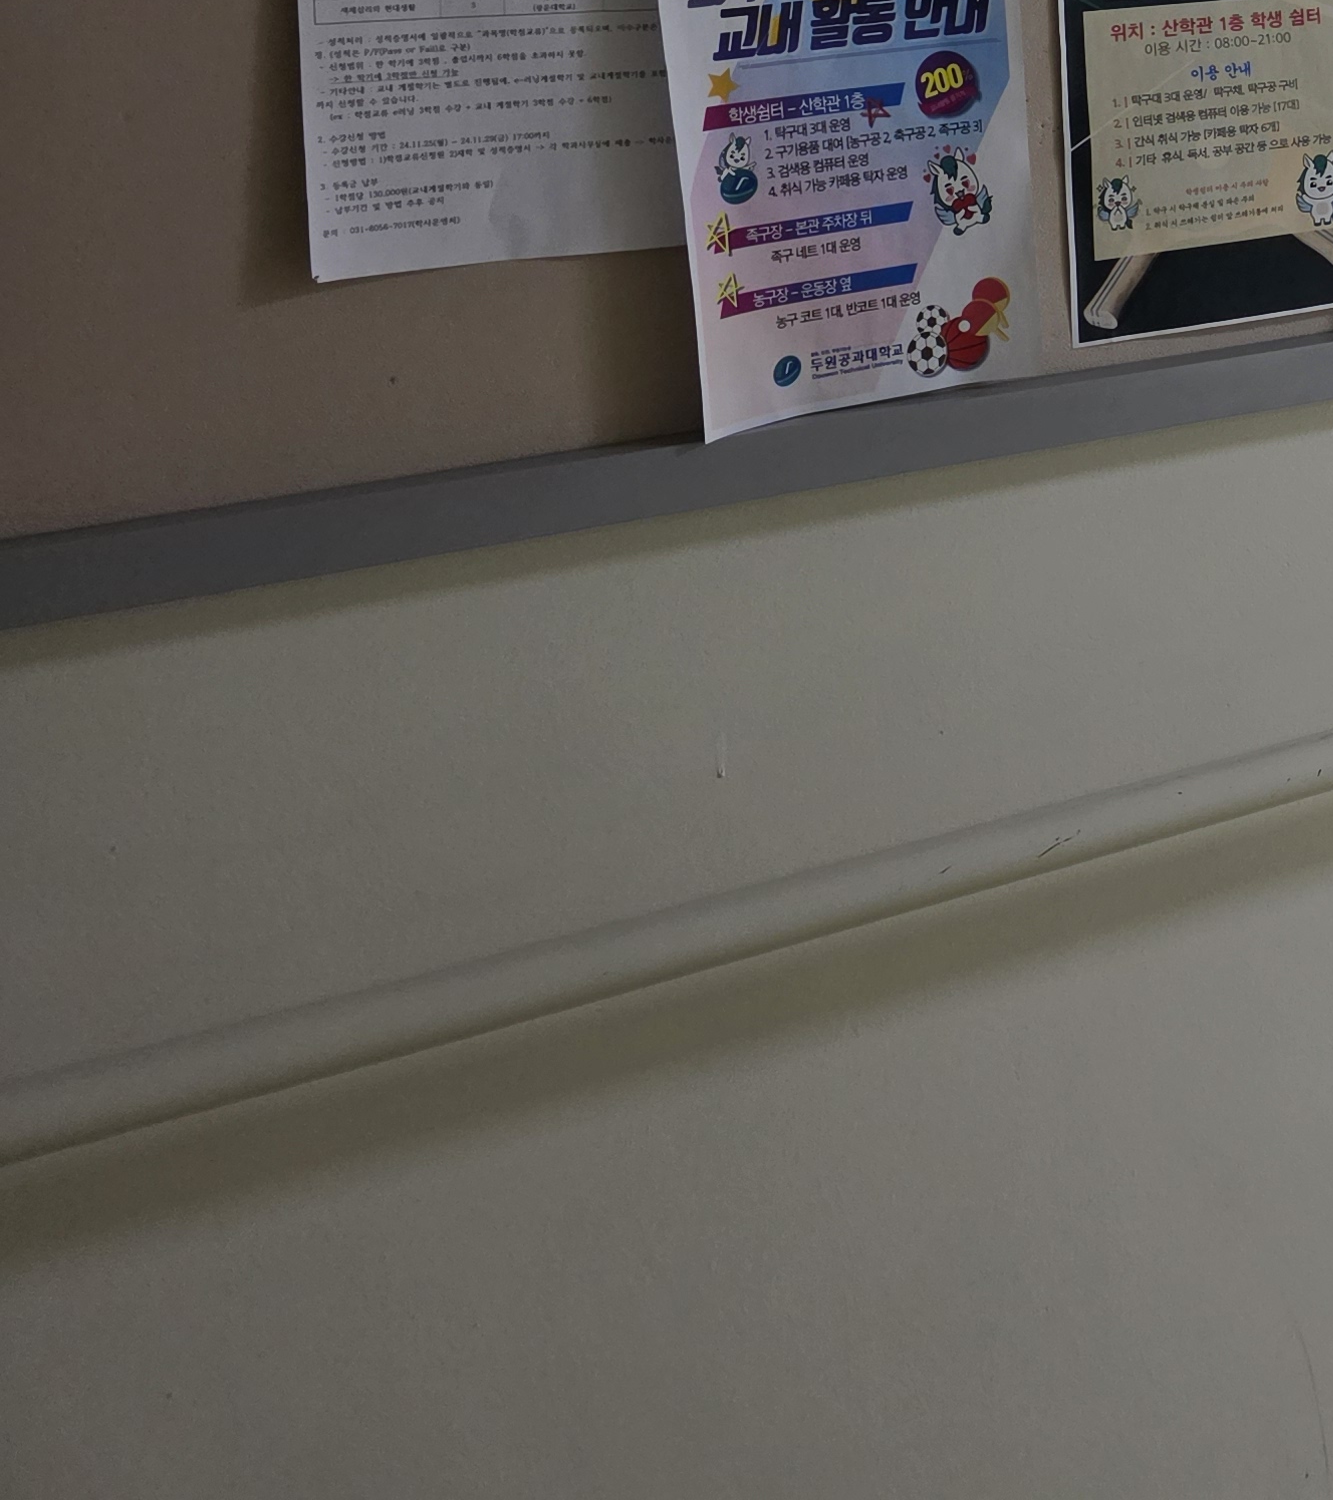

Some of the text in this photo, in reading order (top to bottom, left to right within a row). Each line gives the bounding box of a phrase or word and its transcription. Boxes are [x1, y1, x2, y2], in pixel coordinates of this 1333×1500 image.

[713, 0, 803, 61] 교내
[1110, 7, 1321, 42] 위치 산학관 1층 학생 쉼터
[1144, 41, 1170, 56] 이용
[1176, 39, 1201, 53] 시간
[1191, 61, 1251, 82] 이용 안내
[1279, 78, 1298, 91] 구비
[728, 91, 866, 124] 학생쉼터 산학관 1층
[1132, 113, 1163, 127] 인터넷
[1166, 110, 1196, 124] 검색용
[1199, 106, 1227, 120] 컴퓨터
[1230, 103, 1249, 116] 이용
[1251, 101, 1271, 115] 가능
[775, 123, 808, 139] 탁구대
[810, 121, 828, 135] 3대
[829, 117, 851, 132] 운영
[775, 140, 820, 158] 구기용품
[822, 136, 844, 152] 대여
[894, 125, 926, 141] 축구공
[938, 121, 971, 137] 족구공
[778, 161, 810, 179] 검색용
[813, 157, 845, 175] 컴퓨터
[848, 153, 869, 169] 운영
[780, 180, 803, 196] 취식
[805, 177, 827, 193] 가능
[829, 172, 861, 189] 카페용
[863, 169, 885, 184] 탁자
[887, 165, 908, 180] 운영
[746, 210, 872, 243] 족구장 본관 주차장 뒤
[771, 237, 861, 263] 족구 네트 1대 운영
[753, 276, 852, 308] 농구장 운동장 옆
[776, 313, 798, 329] 농구
[800, 308, 823, 323] 코트
[846, 298, 879, 314] 반코트
[881, 295, 897, 309] 1대
[899, 291, 921, 307] 운영
[811, 344, 904, 372] 두원공과대학교
